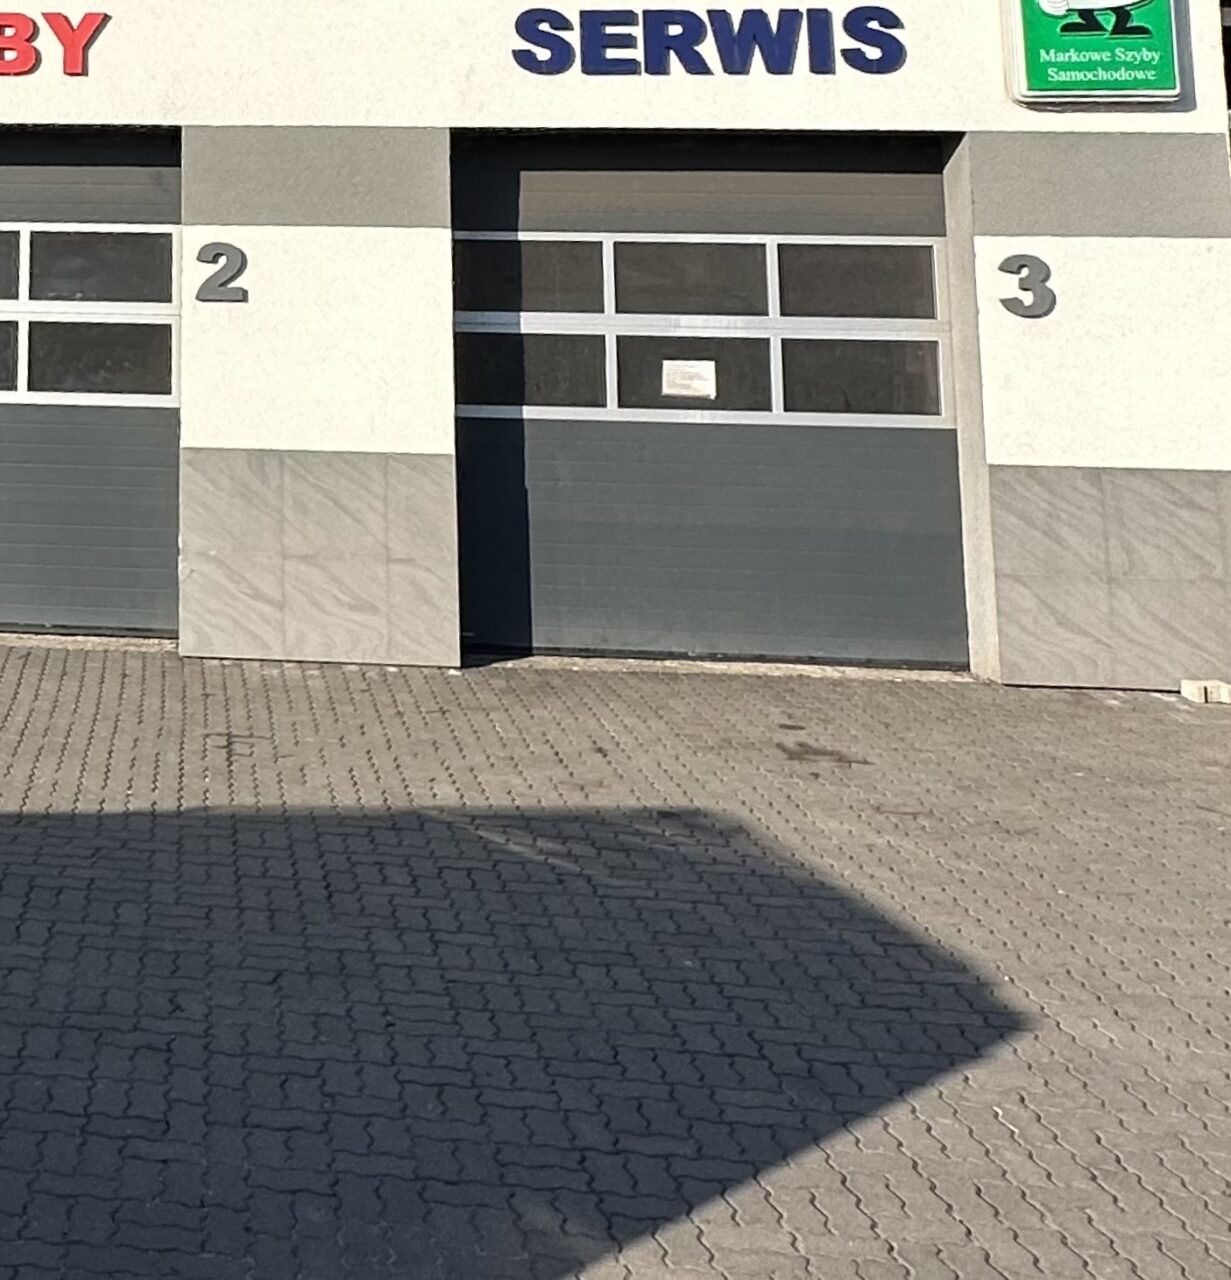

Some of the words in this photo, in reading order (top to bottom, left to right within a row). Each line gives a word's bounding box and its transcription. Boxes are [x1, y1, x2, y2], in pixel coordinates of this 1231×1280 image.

[511, 6, 907, 76] SERWIS
[1039, 48, 1112, 63] Markowe
[1114, 47, 1160, 64] Szyby
[1047, 67, 1157, 82] Samochodowe
[196, 243, 248, 302] 2
[998, 254, 1057, 318] 3
